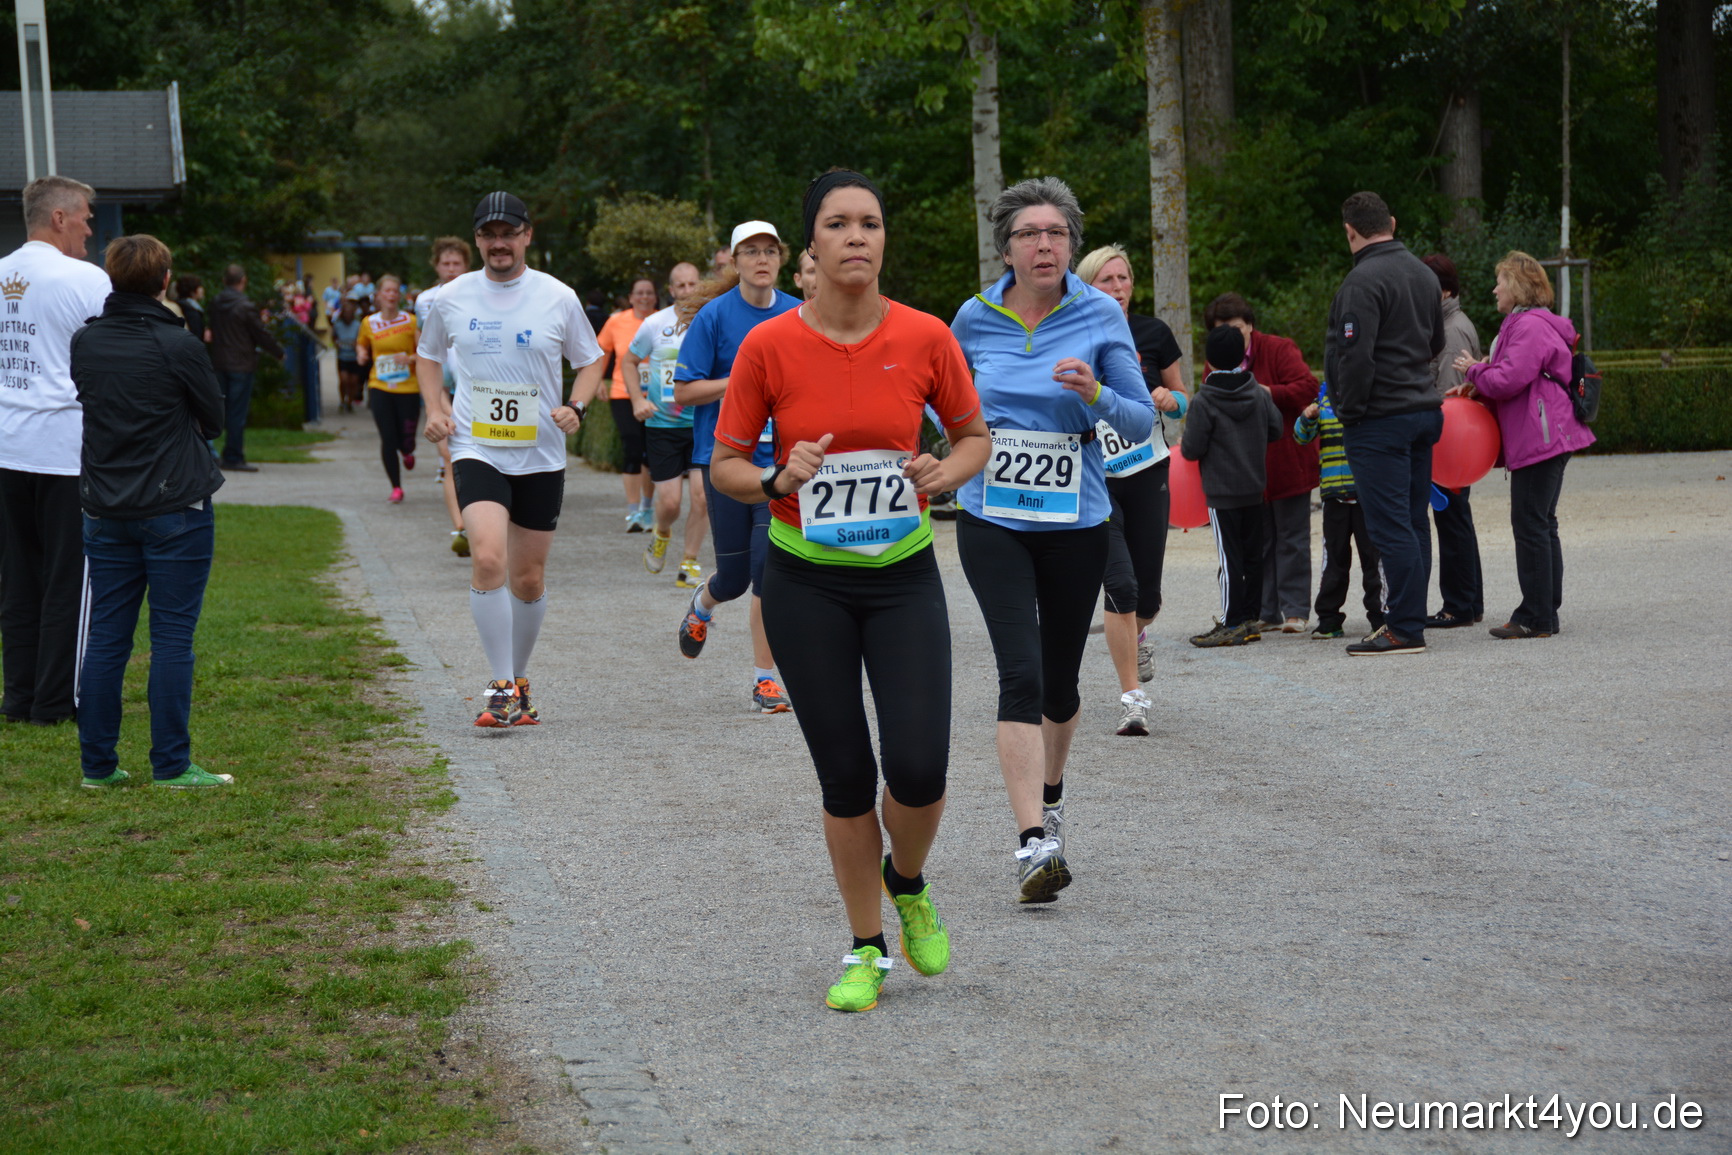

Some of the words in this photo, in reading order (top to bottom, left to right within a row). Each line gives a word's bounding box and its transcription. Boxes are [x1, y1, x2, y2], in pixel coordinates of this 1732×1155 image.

[7, 302, 18, 314] IM
[0, 321, 35, 335] UFTRAG
[469, 318, 481, 331] 6.
[0, 339, 29, 353] SEINER
[0, 357, 40, 374] AJESTÄT:
[4, 376, 28, 390] JESUS
[472, 386, 493, 395] PARTL
[495, 388, 528, 396] Neumarkt
[490, 397, 519, 422] 36
[489, 428, 516, 438] Heiko
[991, 436, 1019, 447] PARTL
[1021, 439, 1067, 451] Neumarkt
[816, 465, 838, 475] RTL
[841, 460, 893, 473] Neumarkt
[994, 450, 1074, 488] 2229
[1107, 452, 1143, 472] Angelika
[812, 474, 908, 519] 2772
[1018, 493, 1044, 508] Anni
[837, 526, 890, 543] Sandra
